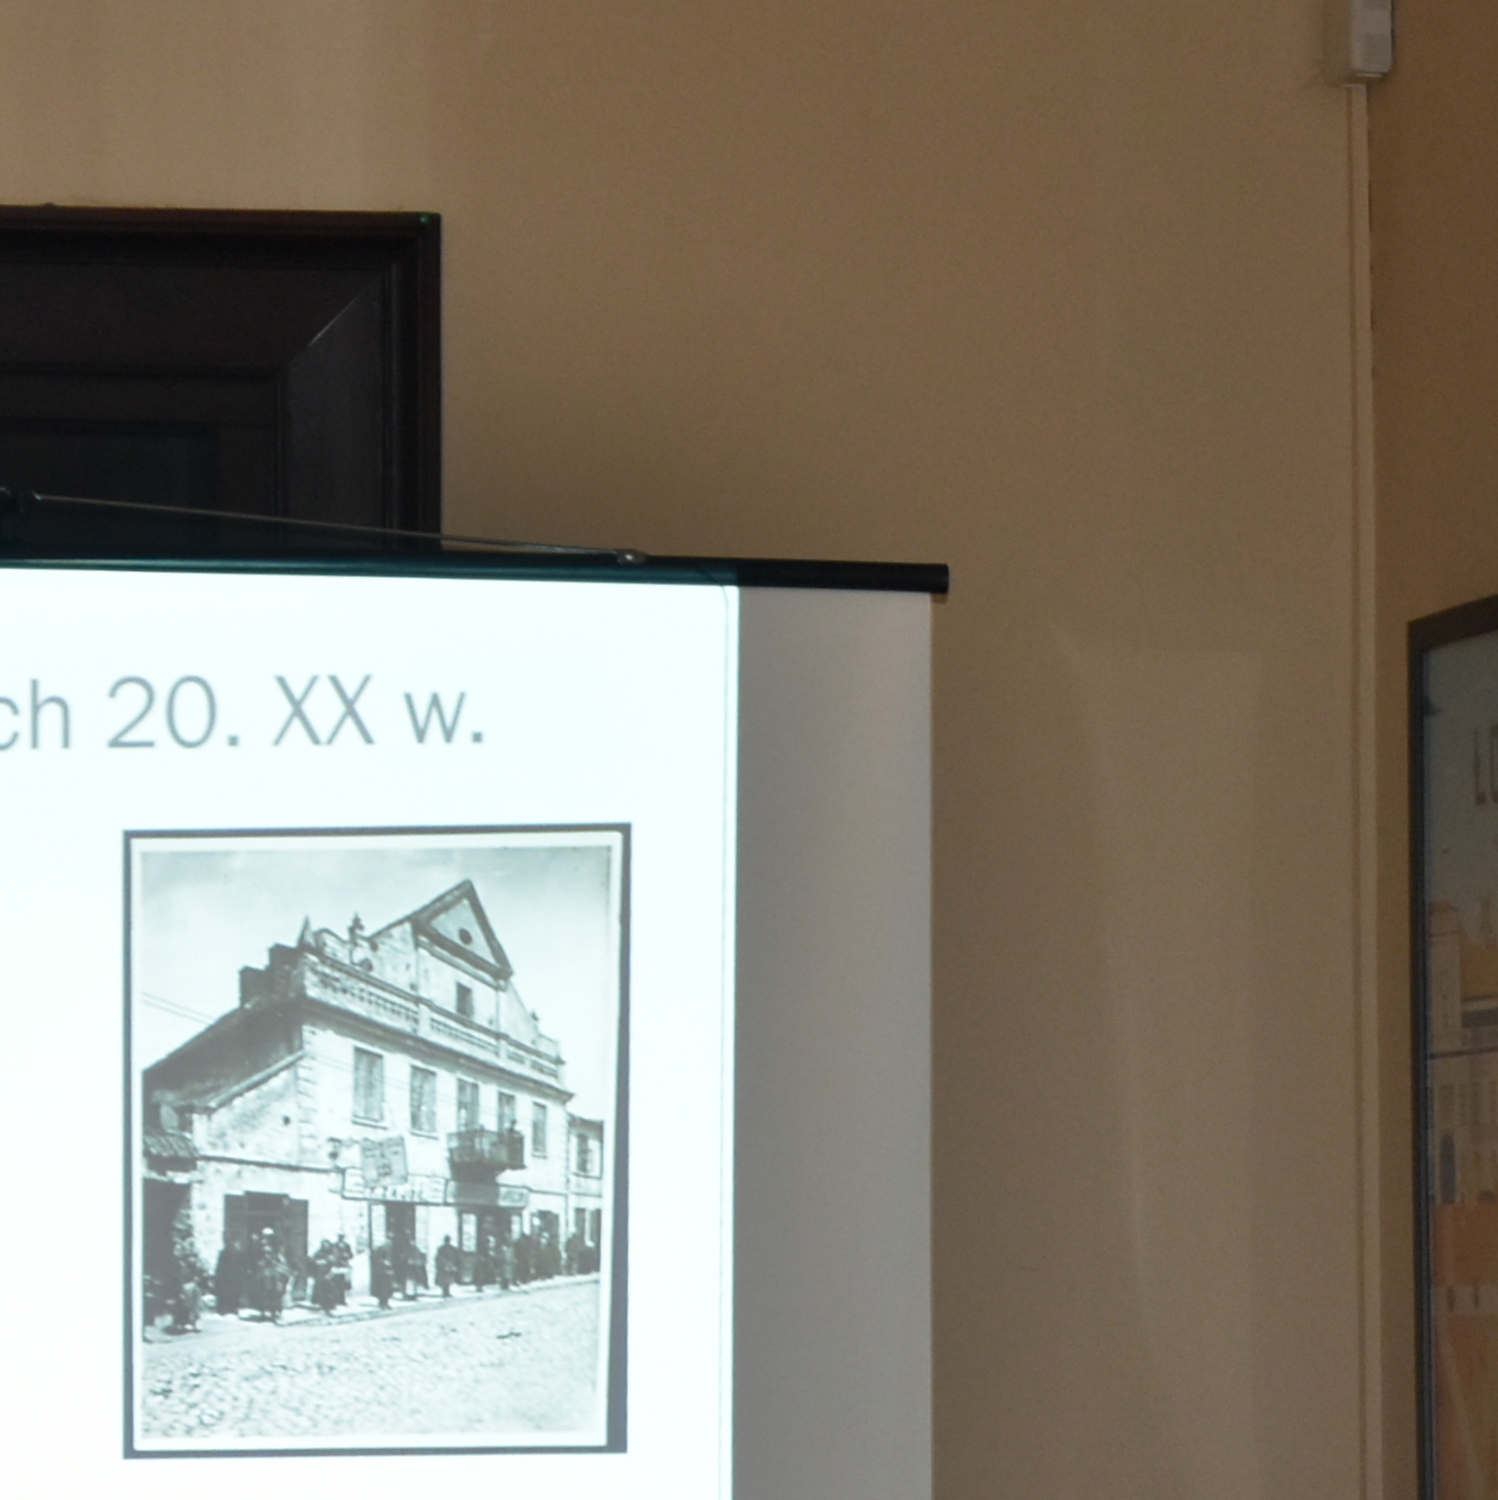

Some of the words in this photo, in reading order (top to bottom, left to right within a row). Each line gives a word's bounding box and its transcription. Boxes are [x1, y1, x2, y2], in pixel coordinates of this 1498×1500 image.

[107, 675, 241, 749] 20.
[272, 674, 376, 747] XX
[403, 691, 485, 746] w.
